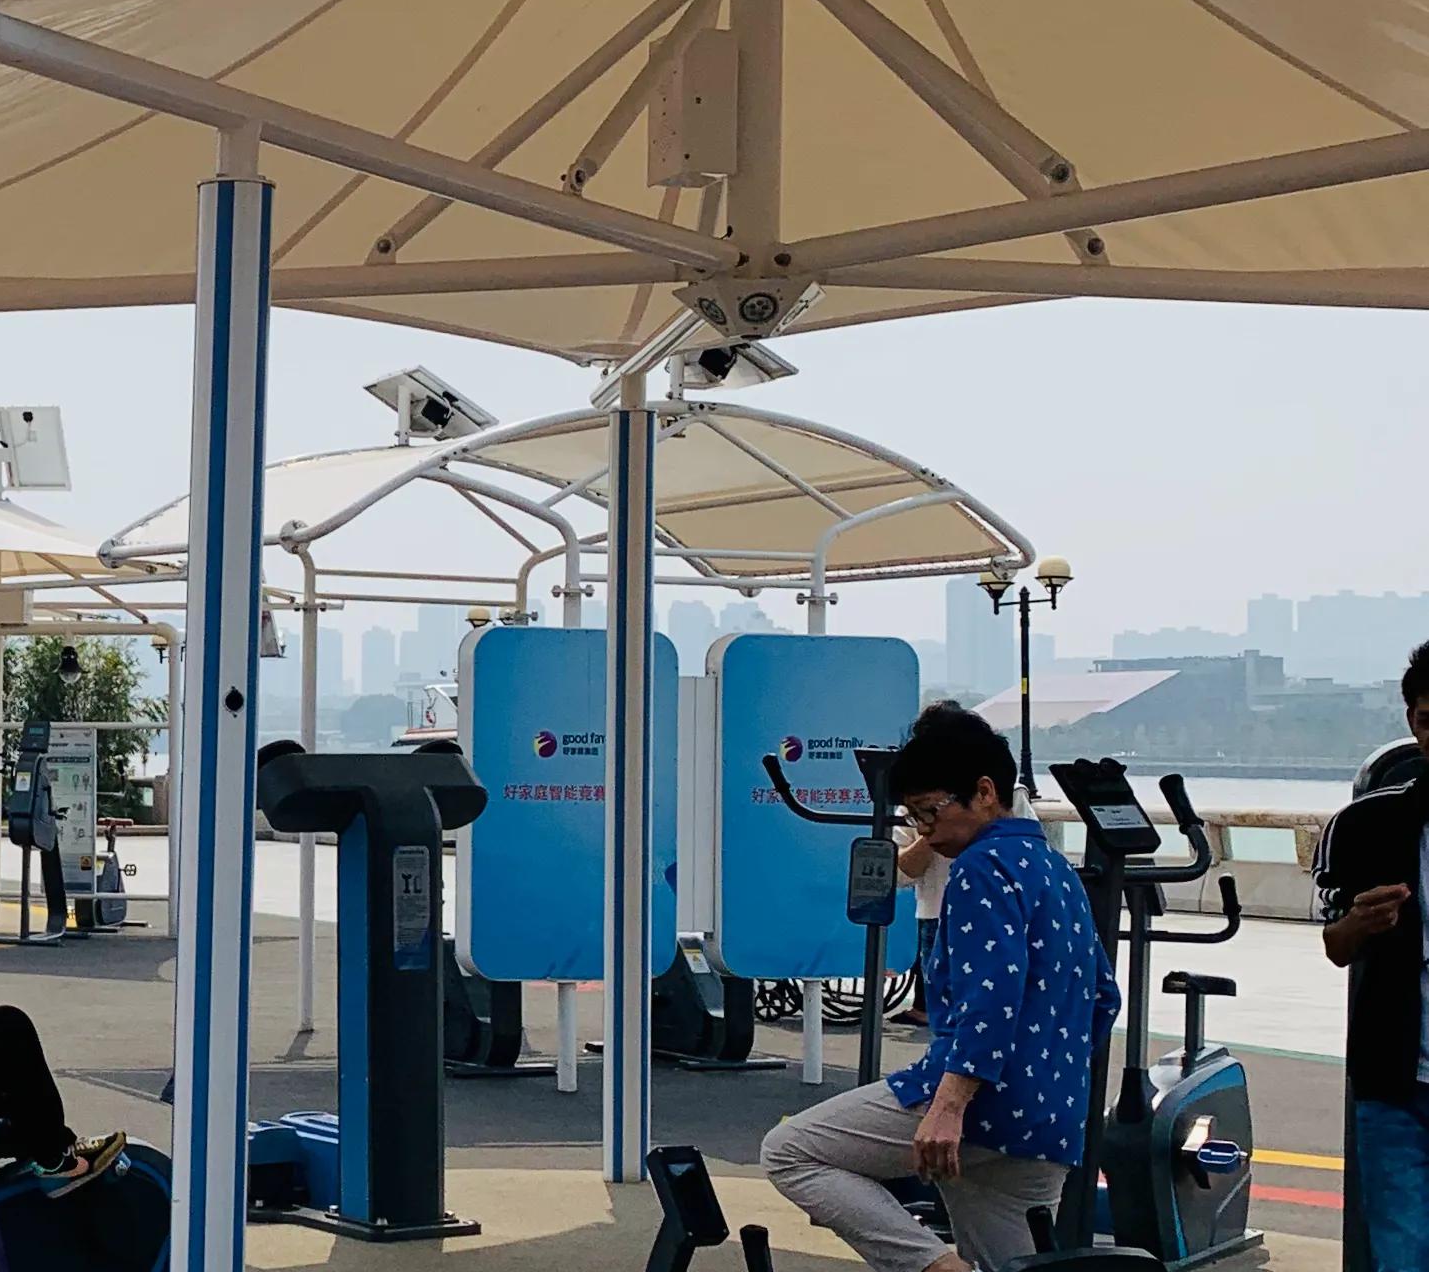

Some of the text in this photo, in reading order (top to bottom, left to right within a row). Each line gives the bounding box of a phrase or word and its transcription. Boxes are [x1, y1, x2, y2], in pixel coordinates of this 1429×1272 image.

[562, 733, 588, 746] good
[807, 736, 864, 750] good family
[751, 788, 872, 805] 好家智能竞赛系
